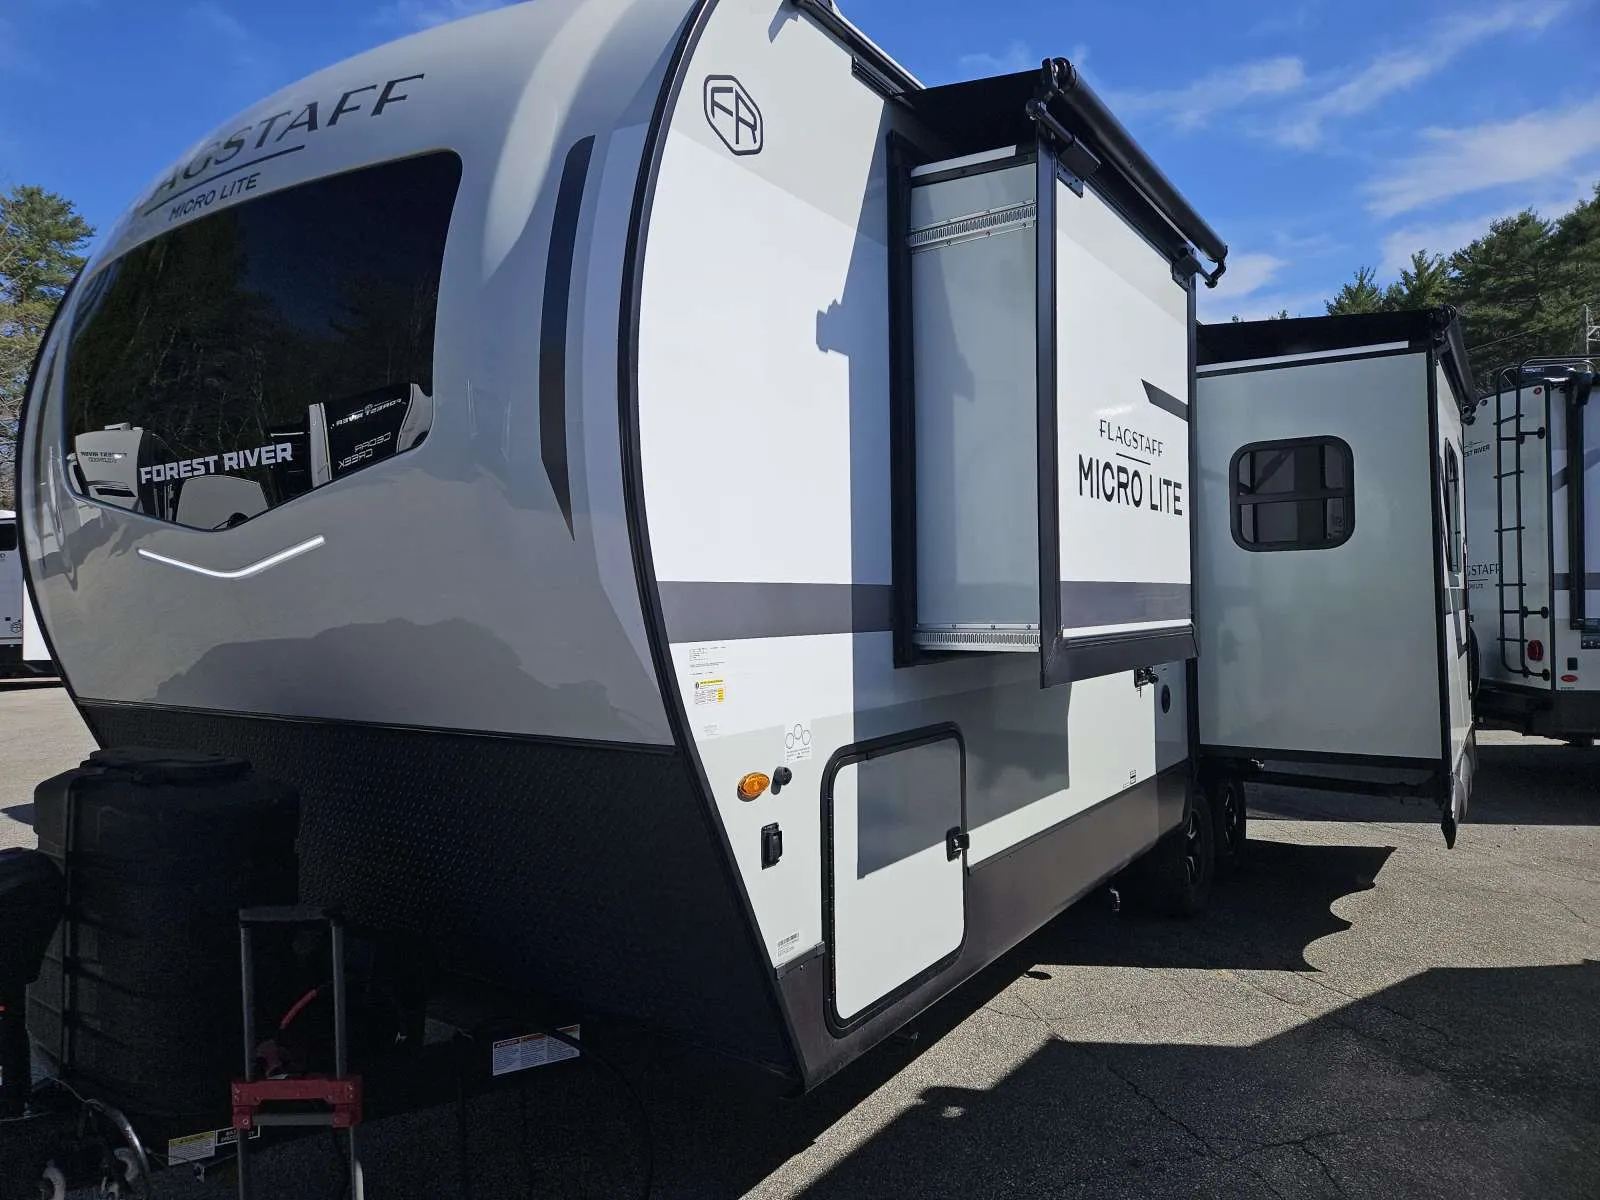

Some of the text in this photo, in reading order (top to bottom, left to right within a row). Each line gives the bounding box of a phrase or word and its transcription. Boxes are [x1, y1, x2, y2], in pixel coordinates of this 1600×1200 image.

[168, 172, 261, 221] MICRO LITE
[1099, 419, 1163, 457] FLAGSTAFF
[140, 442, 293, 485] FOREST RIVER
[1078, 453, 1183, 516] MICRO LITE
